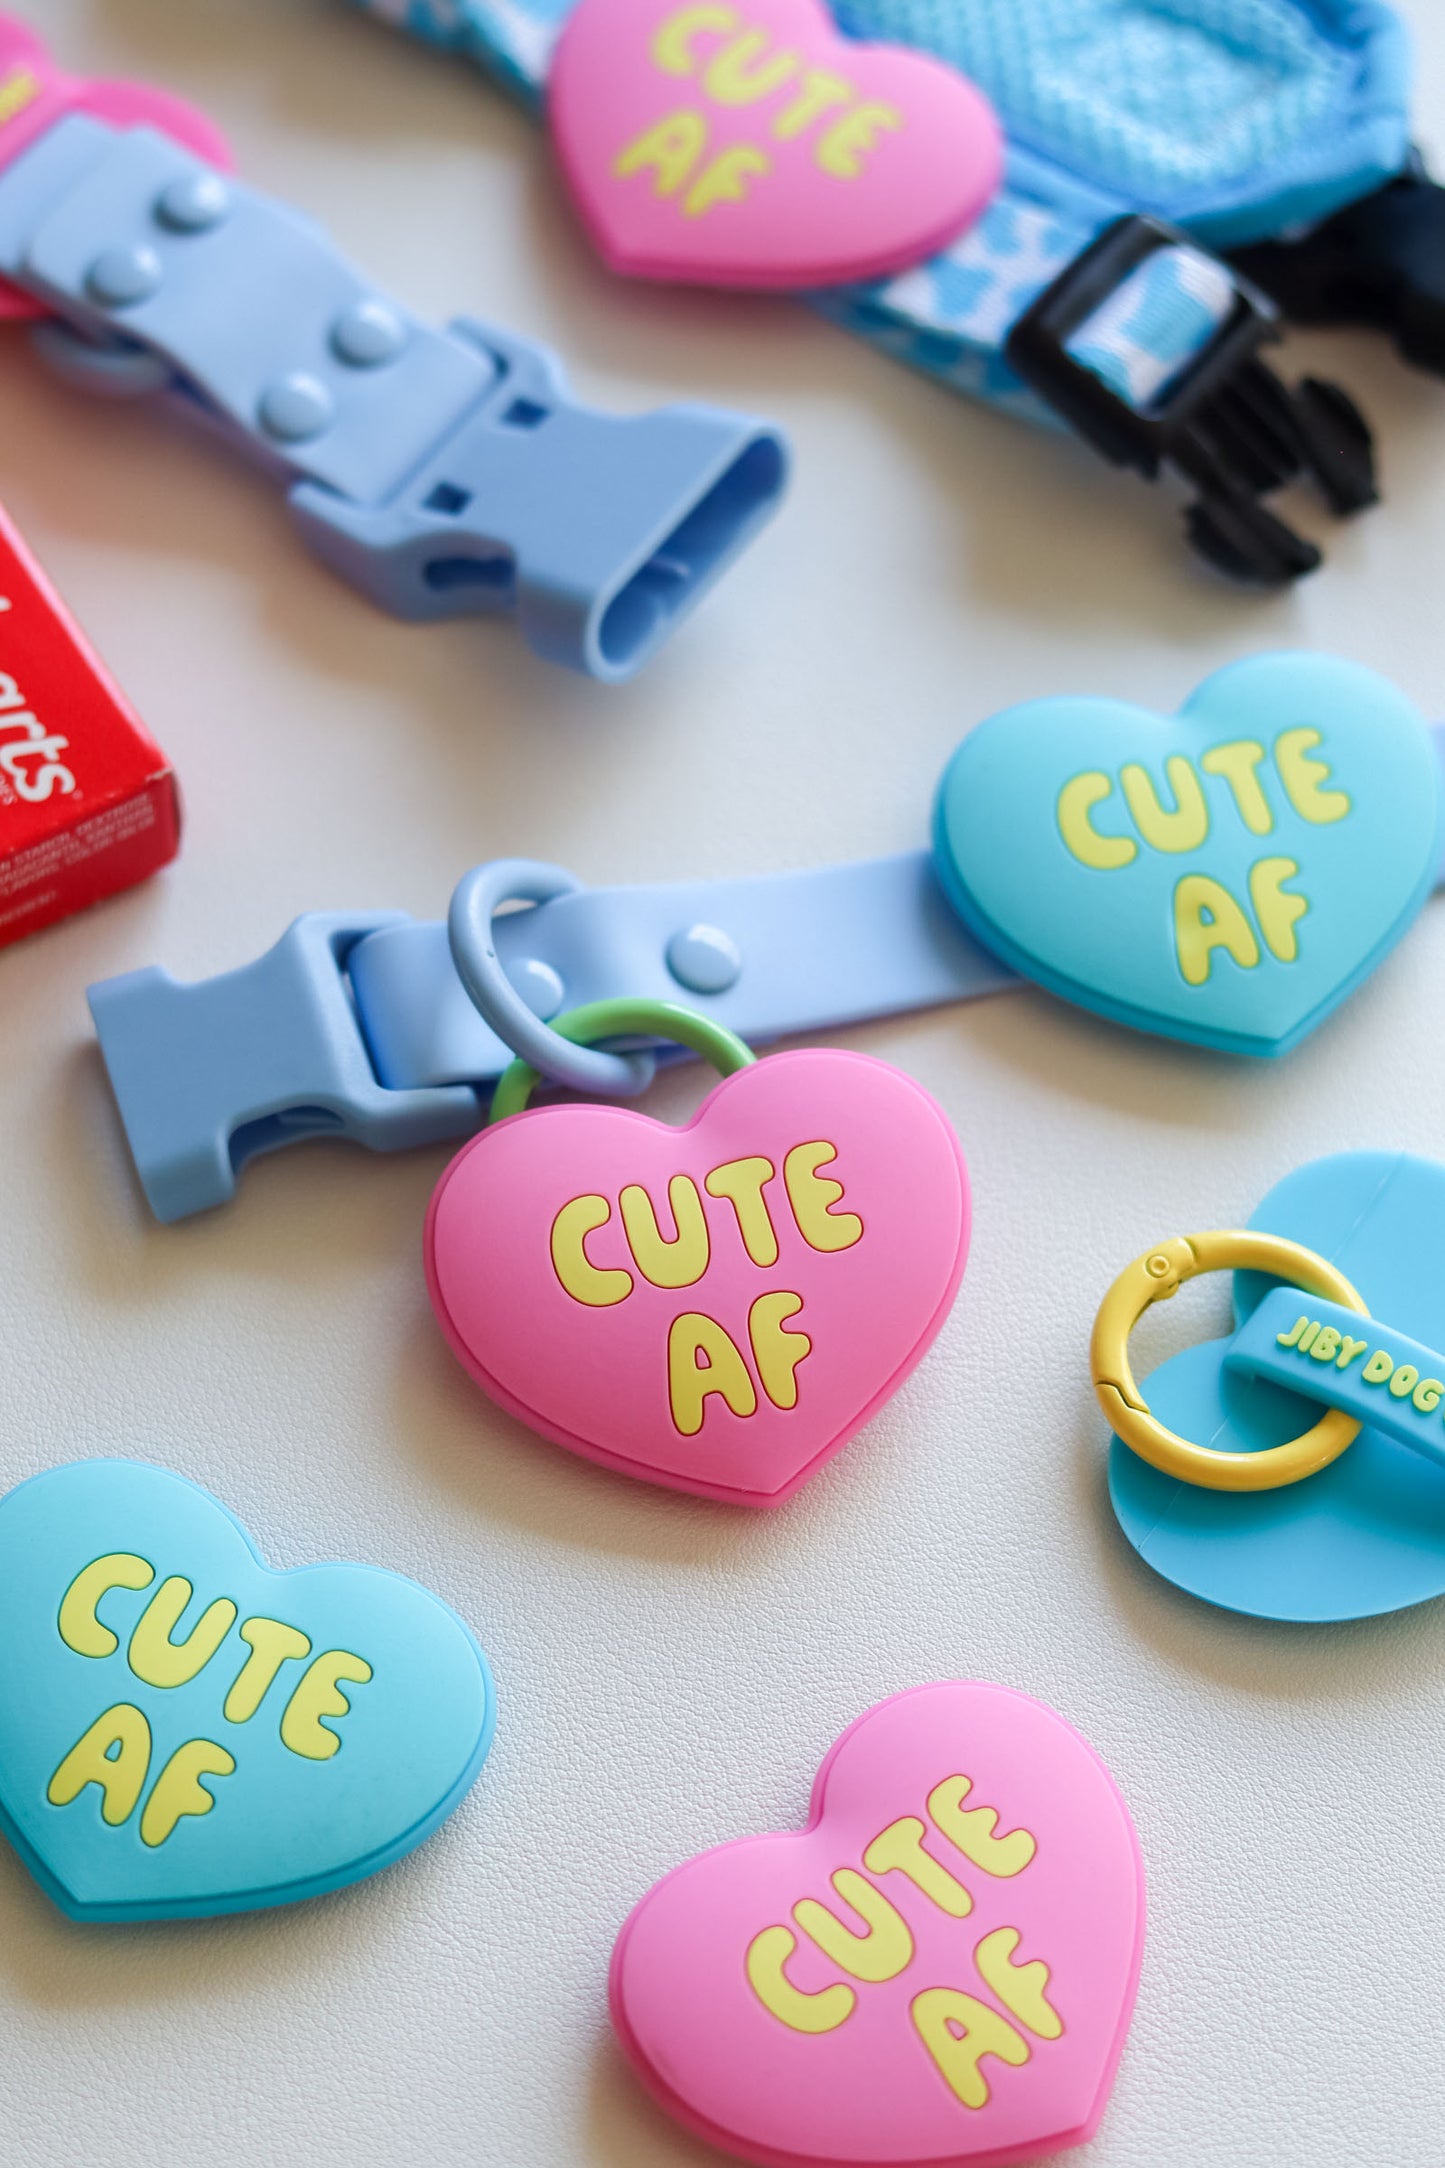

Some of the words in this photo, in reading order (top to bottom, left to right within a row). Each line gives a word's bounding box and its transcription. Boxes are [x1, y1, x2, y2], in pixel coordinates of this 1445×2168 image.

[613, 109, 772, 219] AF
[653, 5, 901, 180] CUTE
[1058, 729, 1350, 869] CUTE
[1175, 858, 1308, 985] AF
[551, 1140, 864, 1307] CUTE
[668, 1291, 811, 1436] AF
[1276, 1316, 1367, 1368] JIBY
[1362, 1350, 1445, 1412] DOG
[58, 1552, 373, 1761] CUTE
[46, 1702, 236, 1848] AF
[746, 1774, 1037, 2034] CUTE
[911, 1927, 1064, 2109] AF
